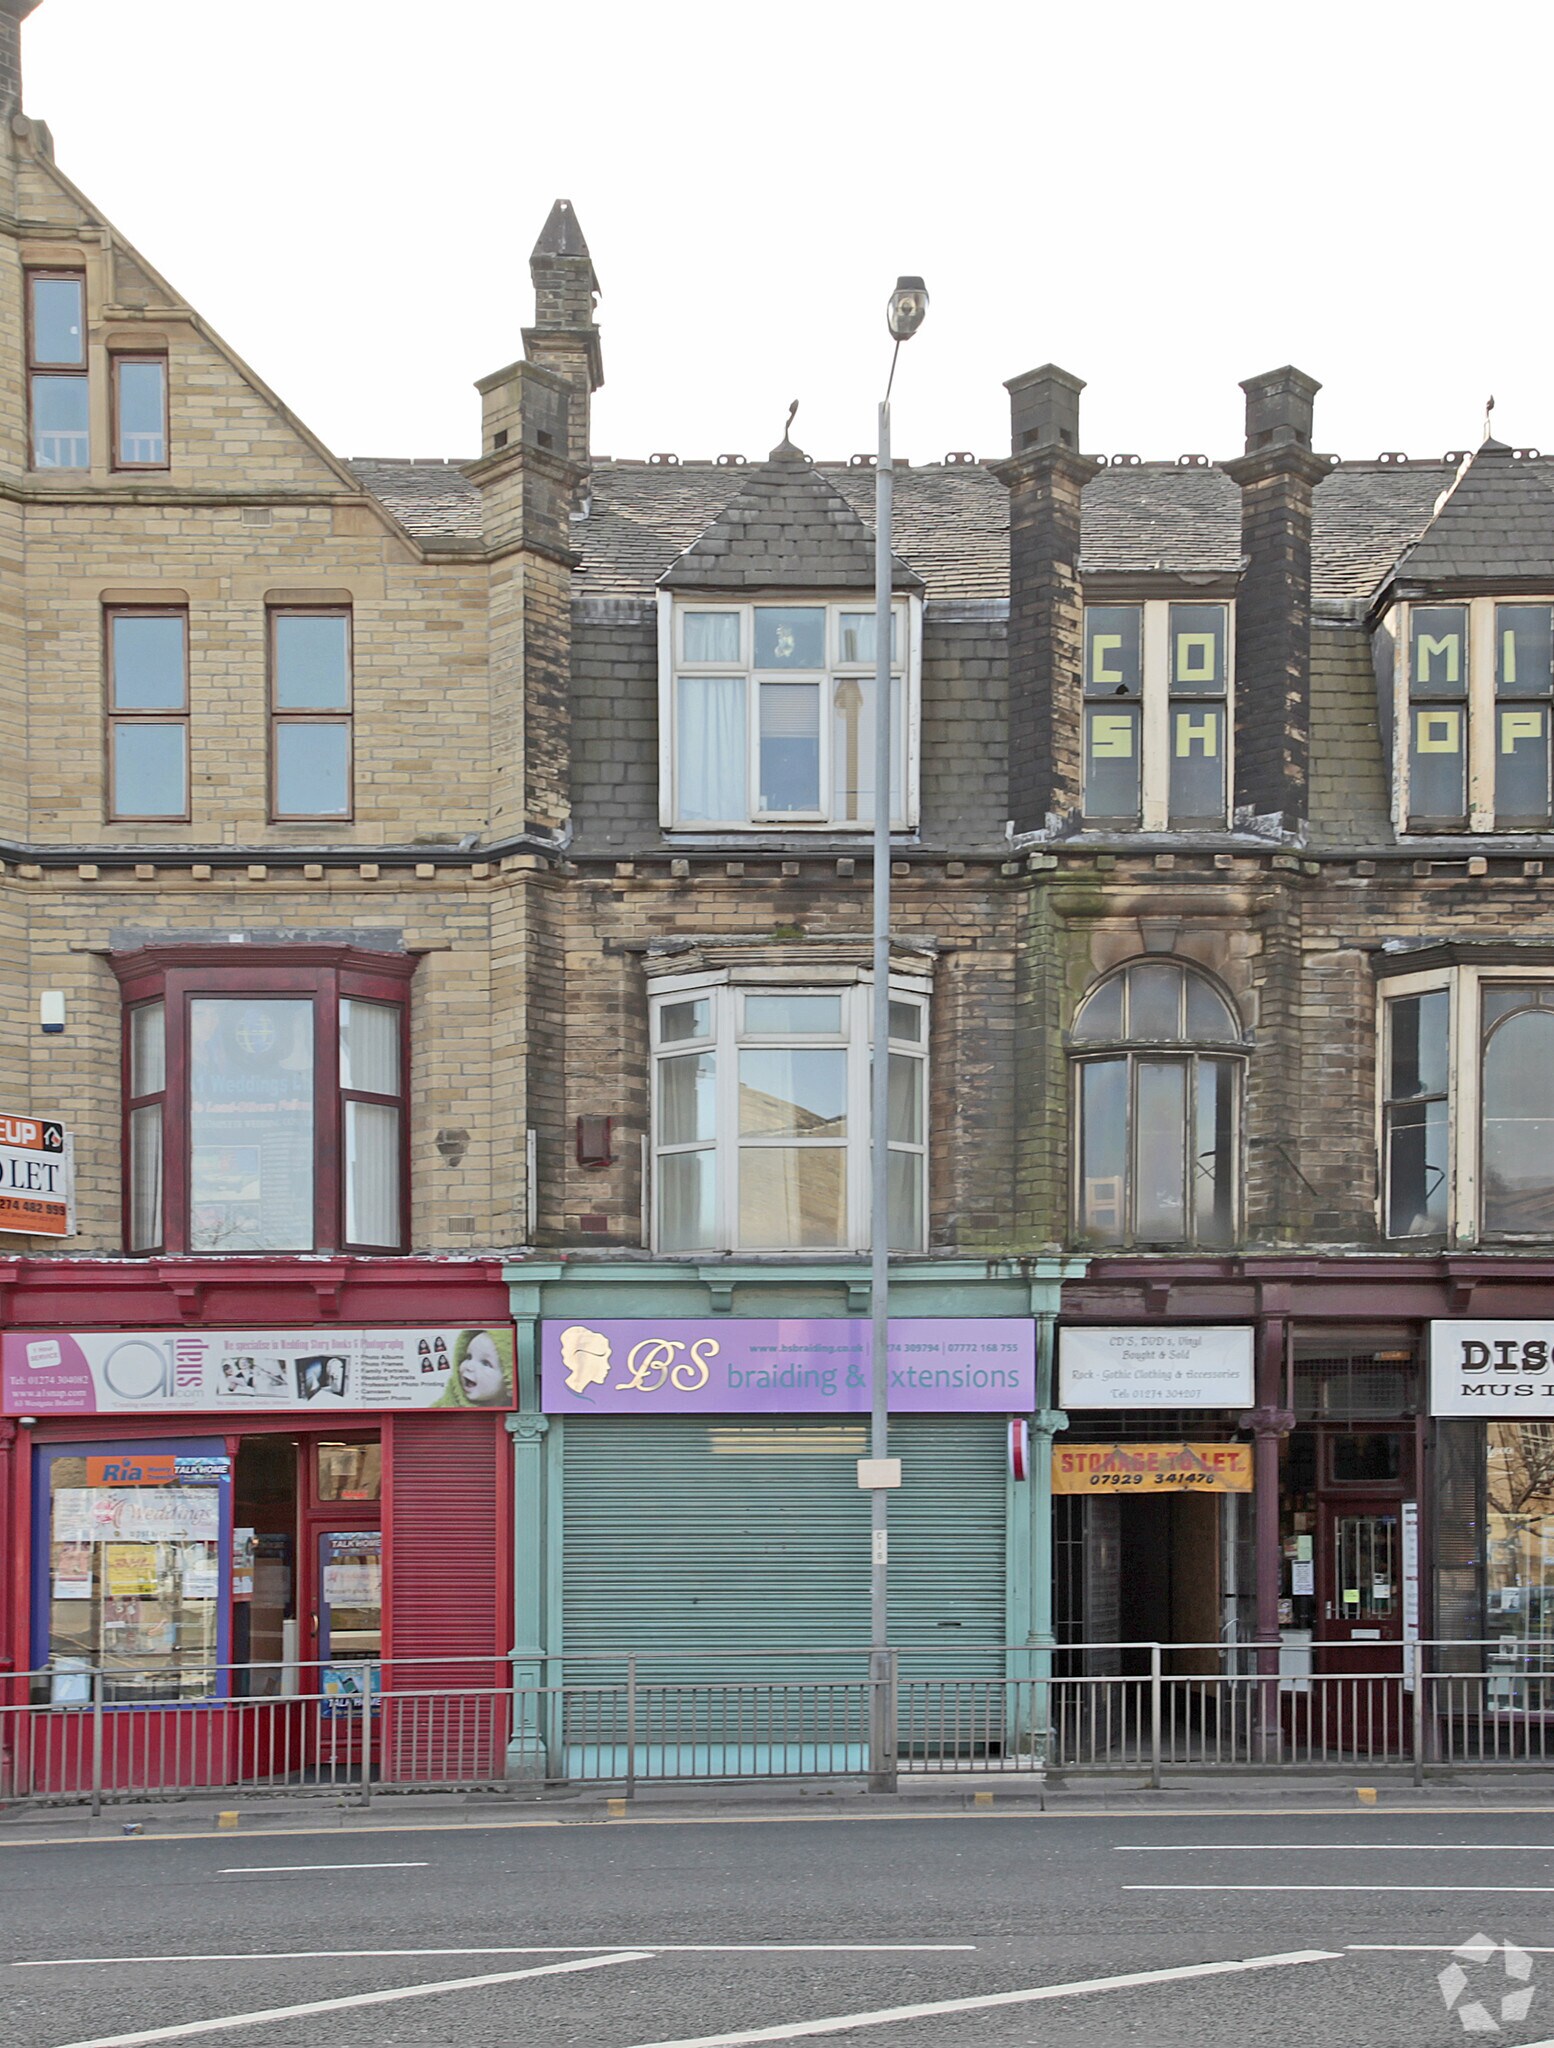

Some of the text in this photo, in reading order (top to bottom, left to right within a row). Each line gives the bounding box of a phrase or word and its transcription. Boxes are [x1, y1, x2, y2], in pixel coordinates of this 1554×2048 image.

[9, 1159, 59, 1192] LET
[948, 1343, 977, 1352] 07772
[1000, 1343, 1018, 1352] 755
[1121, 1350, 1156, 1361] Bought
[1168, 1350, 1190, 1360] Sold
[1461, 1340, 1554, 1376] DIS
[176, 1338, 209, 1388] snap
[728, 1363, 1020, 1397] braiding & xtensions
[1134, 1369, 1172, 1381] Clothing
[102, 1458, 143, 1481] Ria
[1061, 1452, 1158, 1473] STORAGE
[1165, 1452, 1195, 1472] TO
[1090, 1473, 1215, 1486] 07929 341476
